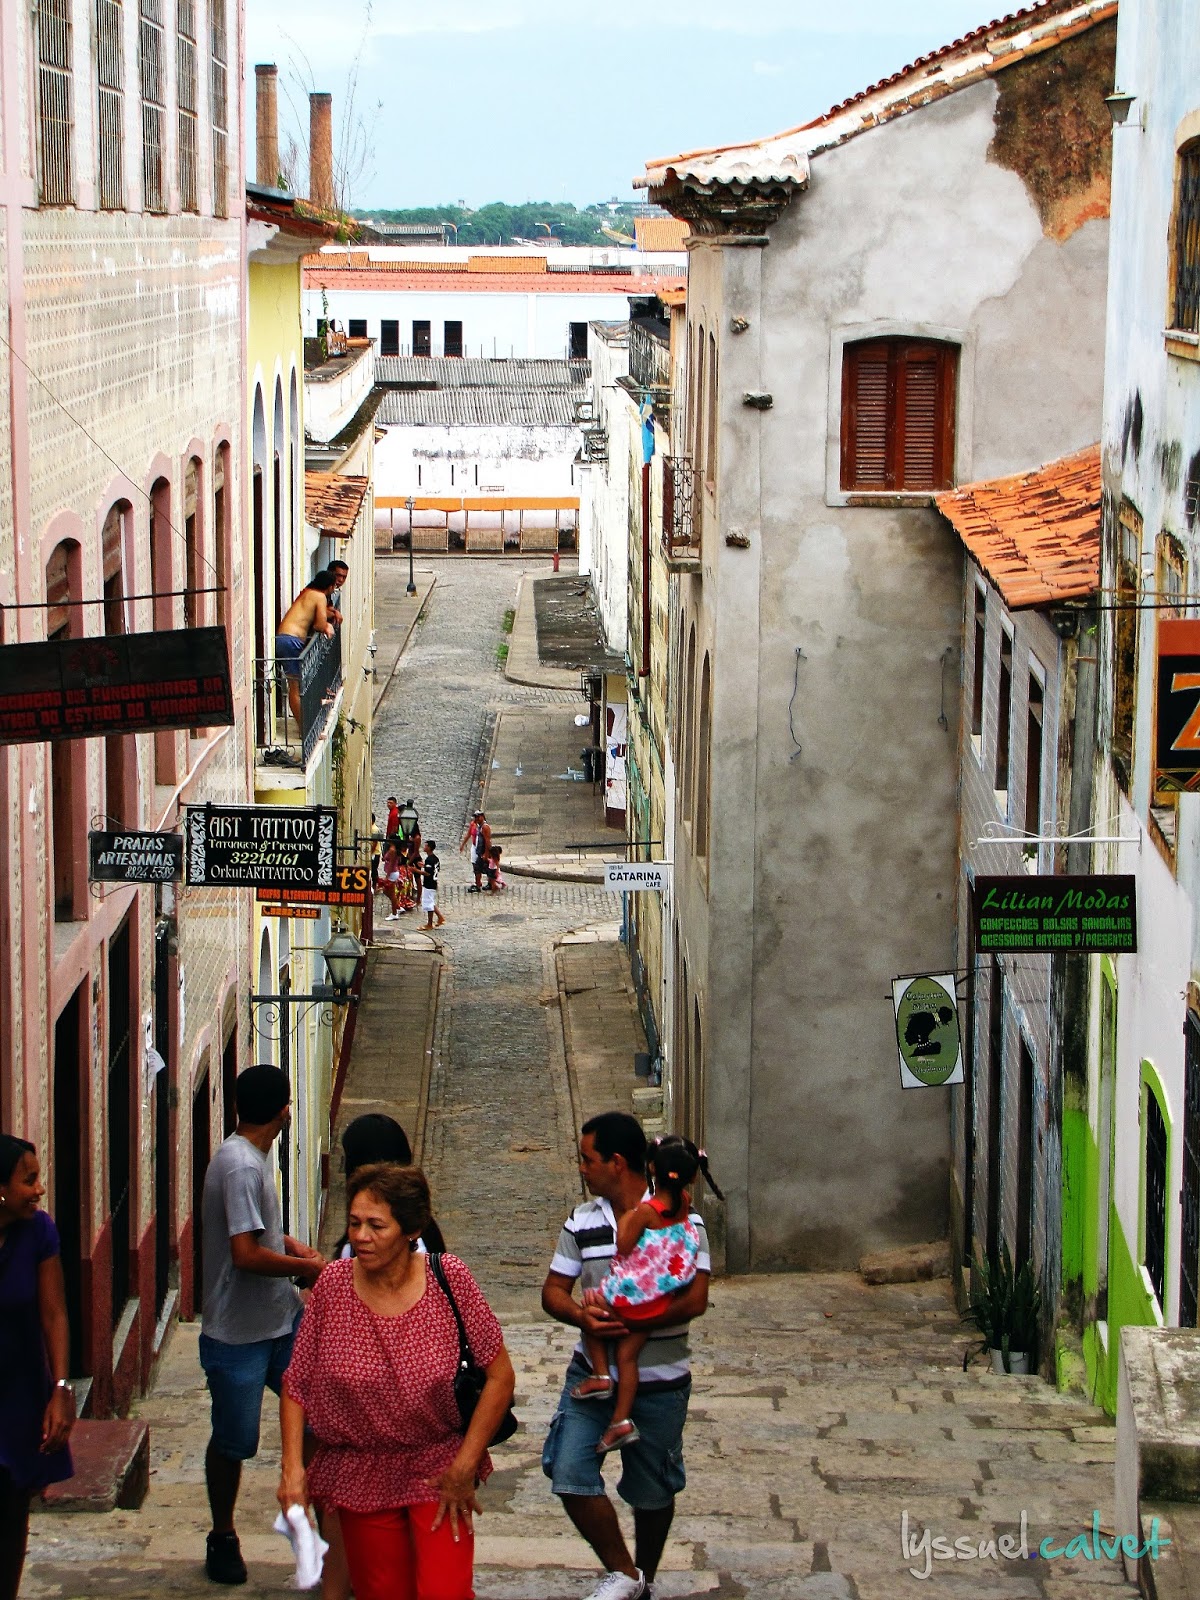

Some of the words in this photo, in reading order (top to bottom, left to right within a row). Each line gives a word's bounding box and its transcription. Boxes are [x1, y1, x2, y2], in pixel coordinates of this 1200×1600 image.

[65, 704, 122, 723] ESTADO
[127, 702, 145, 718] DO
[209, 816, 242, 838] ART
[250, 817, 316, 839] TATTOO
[113, 836, 165, 850] PRATAS
[259, 840, 271, 853] &
[98, 852, 176, 866] ARTESANAIS
[230, 852, 299, 866] 3221-0161
[125, 866, 148, 879] 8824
[210, 864, 314, 881] Orkut:ARTTATTOO
[336, 868, 367, 890] t'S
[609, 872, 662, 881] CATARINA
[1053, 888, 1130, 916] Modas
[980, 916, 1039, 931] CONFECÇÕES
[1043, 917, 1078, 930] BOLSAS
[1081, 915, 1131, 931] SANDÁLIAS
[981, 932, 1034, 947] ACESSÓRIOS
[1035, 932, 1073, 947] ARTIGOS
